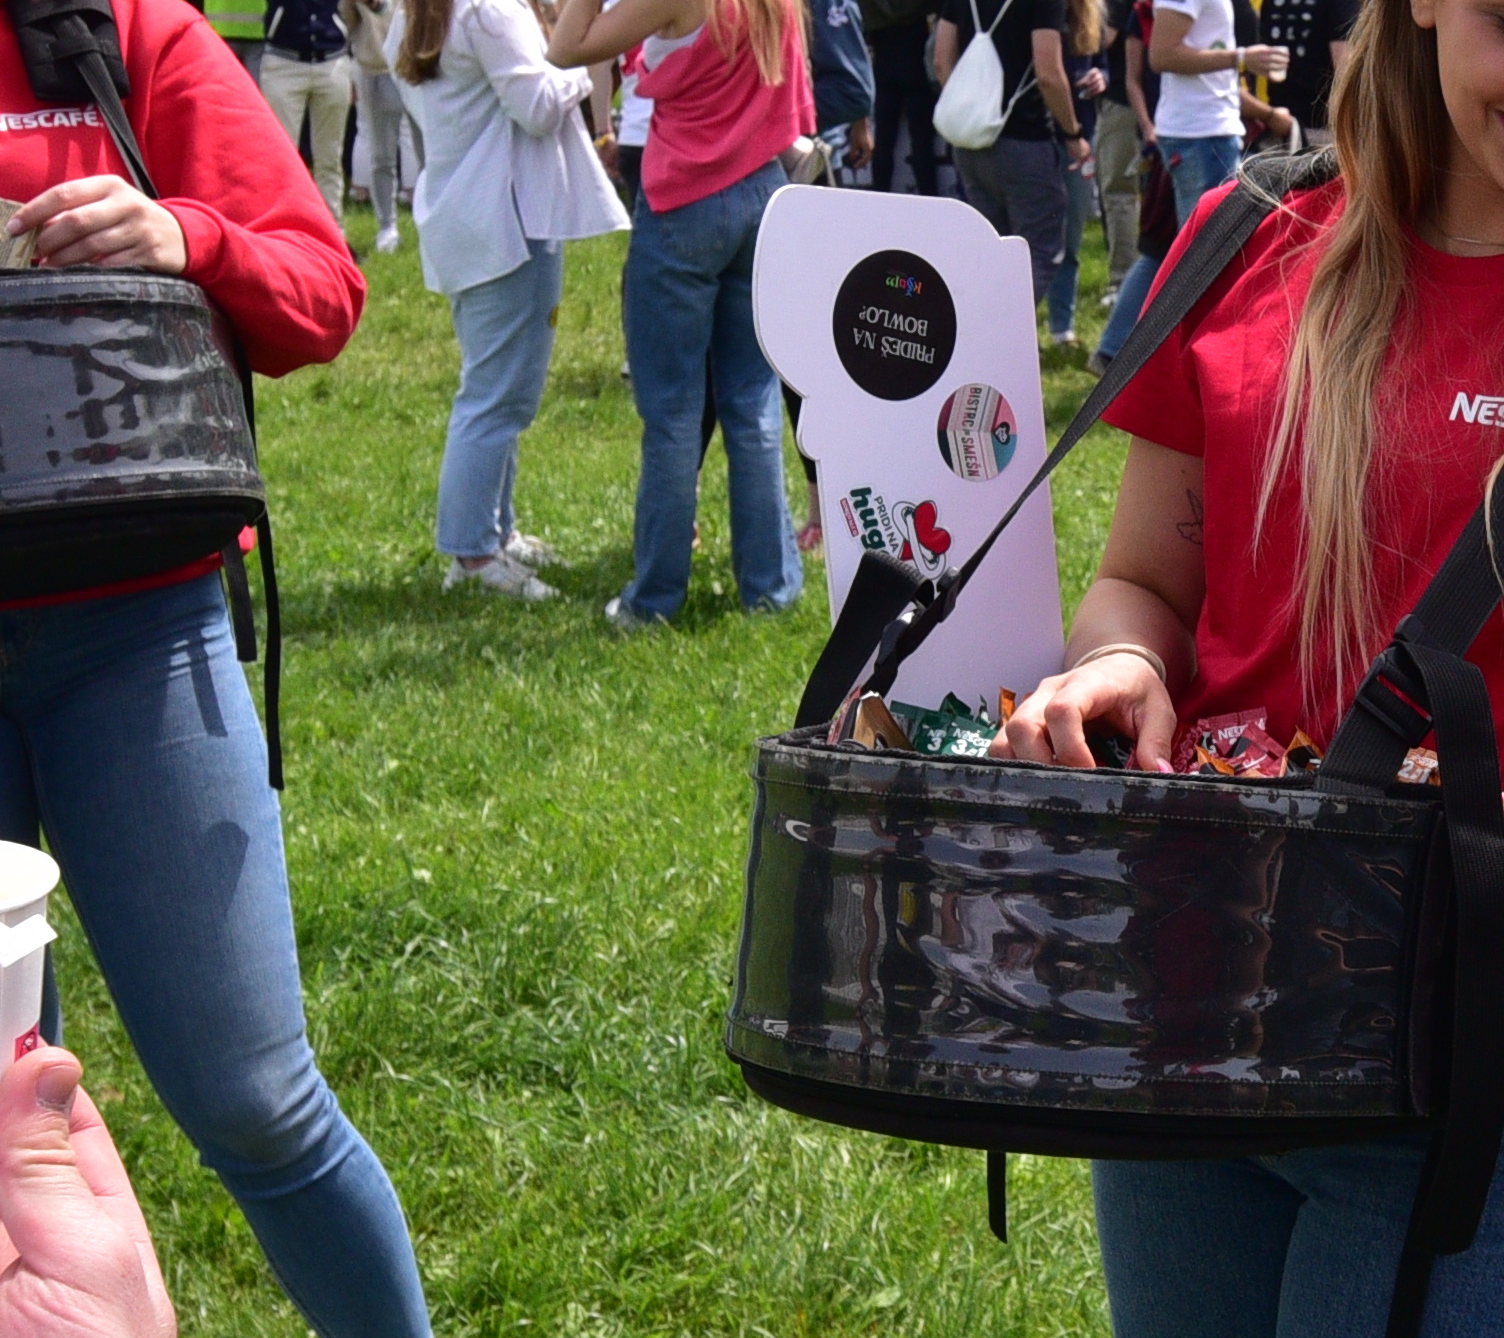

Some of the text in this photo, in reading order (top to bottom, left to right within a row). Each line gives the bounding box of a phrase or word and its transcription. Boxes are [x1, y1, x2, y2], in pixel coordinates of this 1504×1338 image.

[858, 305, 928, 337] BOWLO?
[853, 327, 935, 364] PRIDEŠ NA
[850, 487, 890, 550] hug
[874, 495, 899, 554] PRIDI NA
